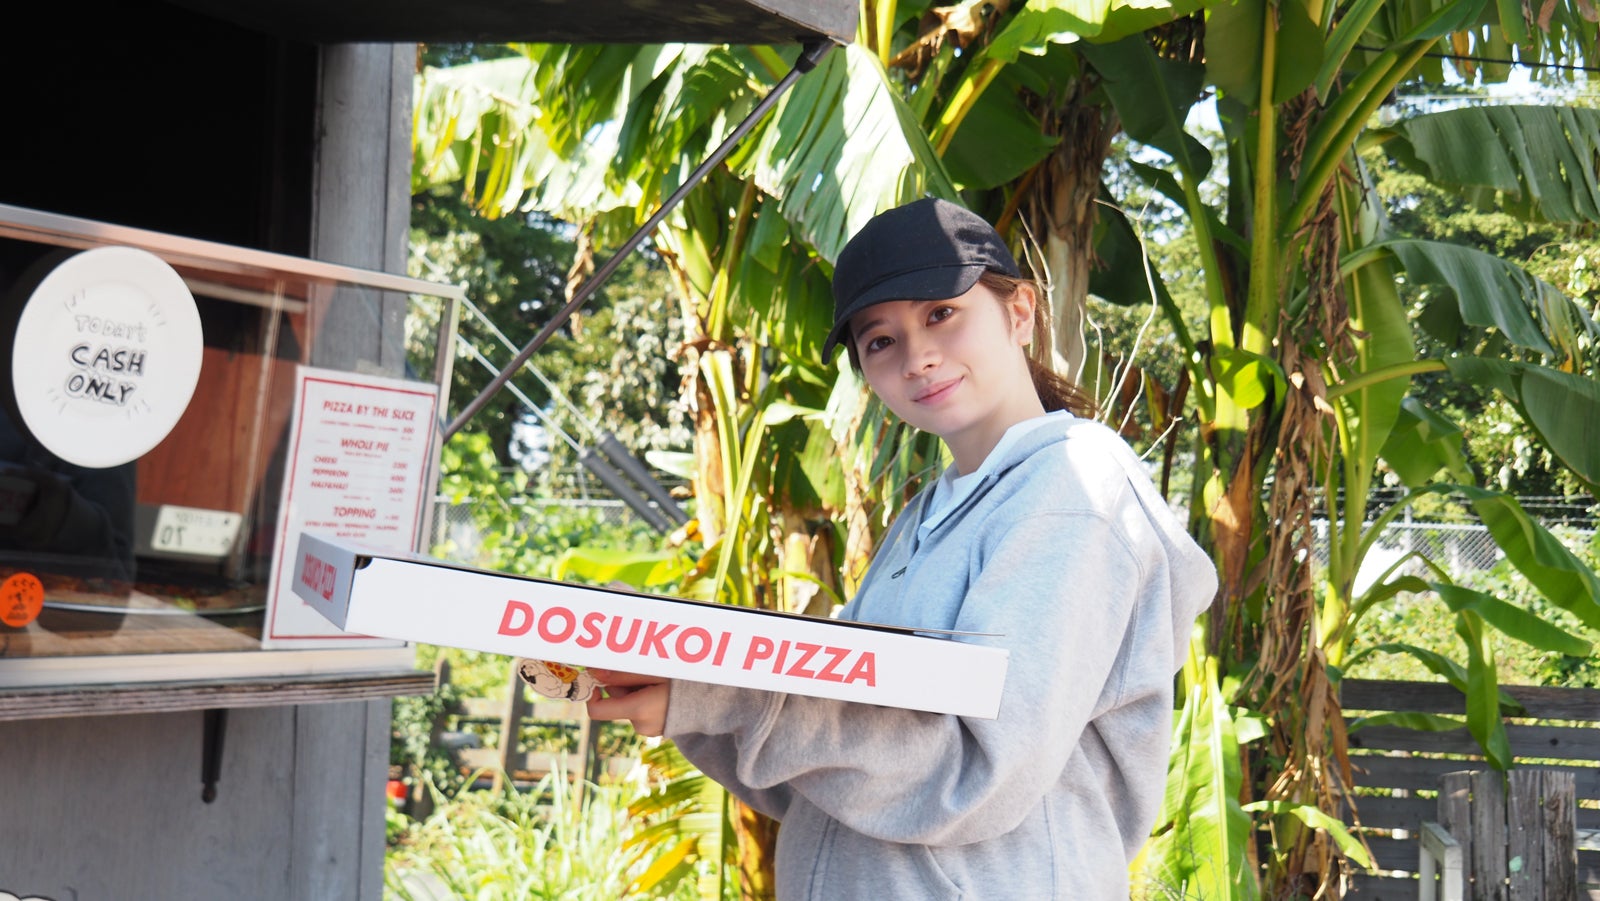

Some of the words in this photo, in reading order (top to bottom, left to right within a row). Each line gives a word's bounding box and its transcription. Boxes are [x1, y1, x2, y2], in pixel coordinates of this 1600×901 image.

[71, 345, 145, 376] CASH
[67, 375, 136, 403] ONLY
[323, 400, 353, 415] PIZZA
[357, 405, 369, 416] BY
[372, 406, 389, 418] THE
[392, 409, 416, 421] SLICE
[340, 438, 374, 450] WHOLE
[376, 441, 390, 452] PIE
[333, 506, 376, 519] TOPPING
[497, 600, 732, 667] DOSUKOI
[742, 635, 876, 687] PIZZA
